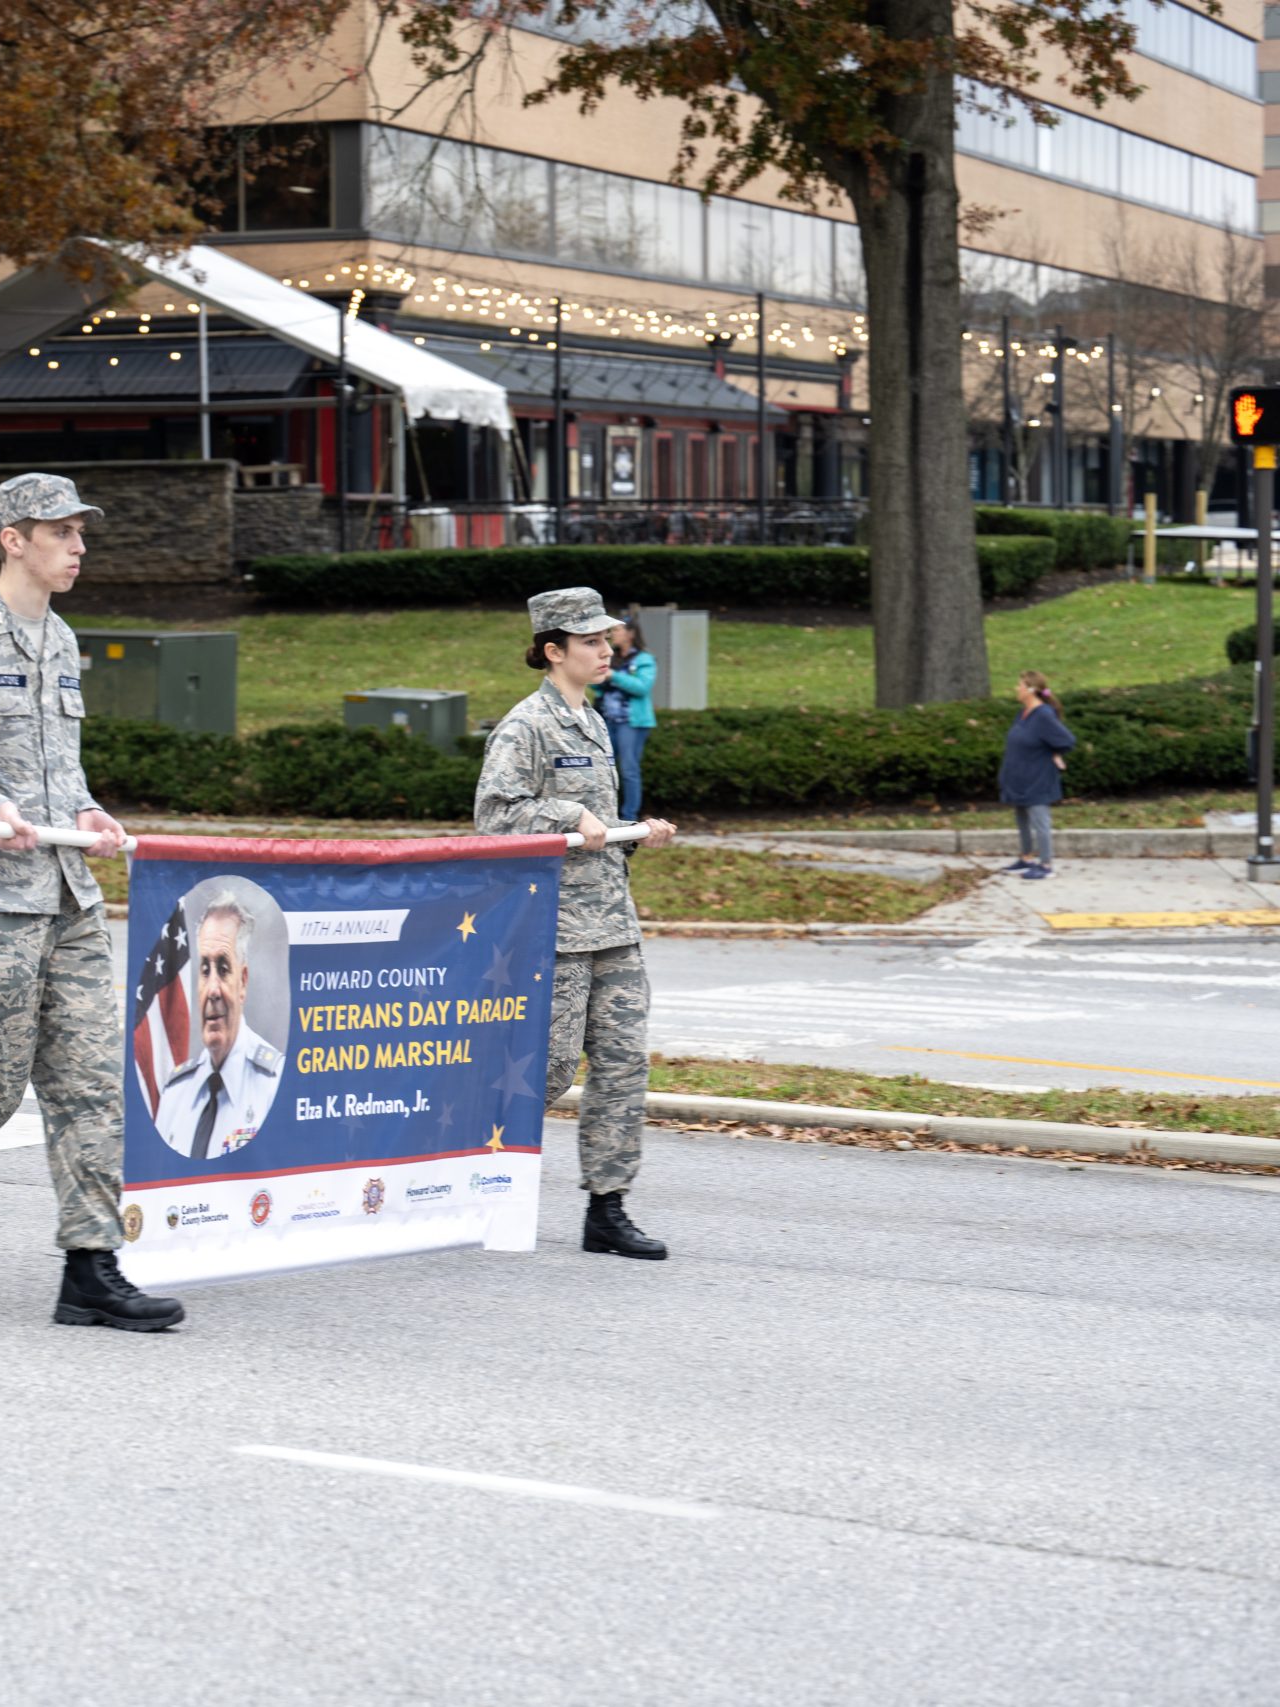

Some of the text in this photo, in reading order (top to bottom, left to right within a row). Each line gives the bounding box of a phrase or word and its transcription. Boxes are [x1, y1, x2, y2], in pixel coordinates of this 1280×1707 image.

[300, 919, 391, 937] 11TH ANNUAL
[300, 967, 448, 991] HOWARD COUNTY
[298, 996, 528, 1032] VETERANS DAY PARADE
[296, 1039, 473, 1074] GRAND MARSHAL
[296, 1089, 431, 1121] Elza K. Redman, Jr.
